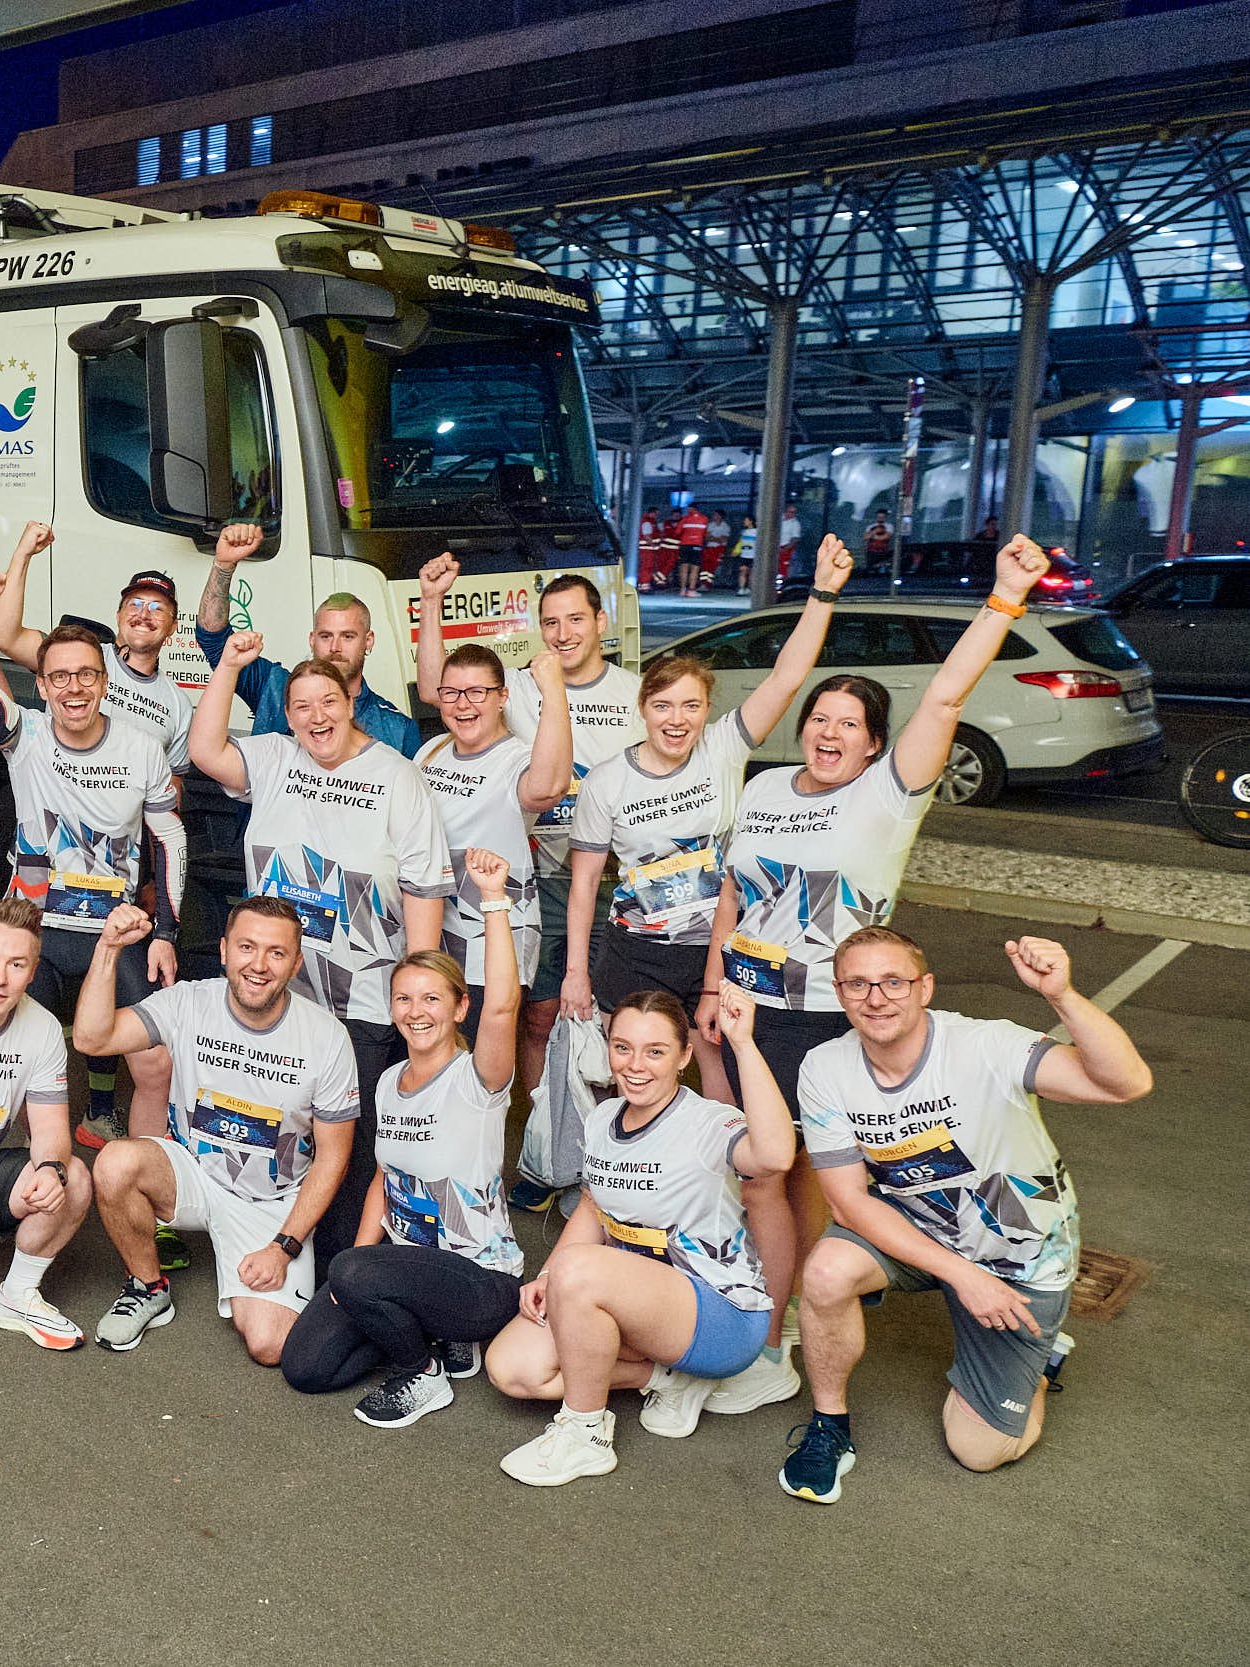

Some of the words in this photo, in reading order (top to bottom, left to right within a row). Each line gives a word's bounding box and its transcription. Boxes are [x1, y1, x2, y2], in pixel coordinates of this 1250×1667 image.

[32, 251, 75, 278] 226
[427, 273, 589, 312] energieag.at/umweltservice
[177, 610, 186, 620] ür
[407, 591, 501, 623] EERGIE
[477, 623, 503, 634] Umwelt
[494, 640, 529, 657] morgen
[126, 703, 166, 728] SERVICE.
[576, 704, 630, 715] UMWELT.
[576, 716, 628, 727] SERVICE.
[81, 766, 131, 777] UMWELT.
[80, 779, 130, 789] SERVICE.
[326, 776, 385, 796] UMWELT.
[320, 792, 377, 811] SERVICE.
[622, 795, 668, 814] UNSERE
[629, 809, 668, 826] UNSER
[75, 875, 100, 885] LUKAS
[281, 884, 322, 901] ELISABETH
[664, 882, 694, 902] 509
[79, 900, 89, 911] 4
[736, 965, 757, 985] 503
[196, 1034, 245, 1055] UNSERE
[248, 1048, 306, 1069] UMWELT.
[197, 1051, 240, 1070] UNSER
[243, 1063, 301, 1085] SERVICE.
[226, 1097, 252, 1111] ALDIN
[218, 1119, 249, 1138] 903
[613, 1162, 662, 1174] UMWELT.
[896, 1164, 936, 1182] 105
[607, 1176, 658, 1191] SERVICE.
[390, 1187, 409, 1204] LINDA
[391, 1212, 411, 1233] 137
